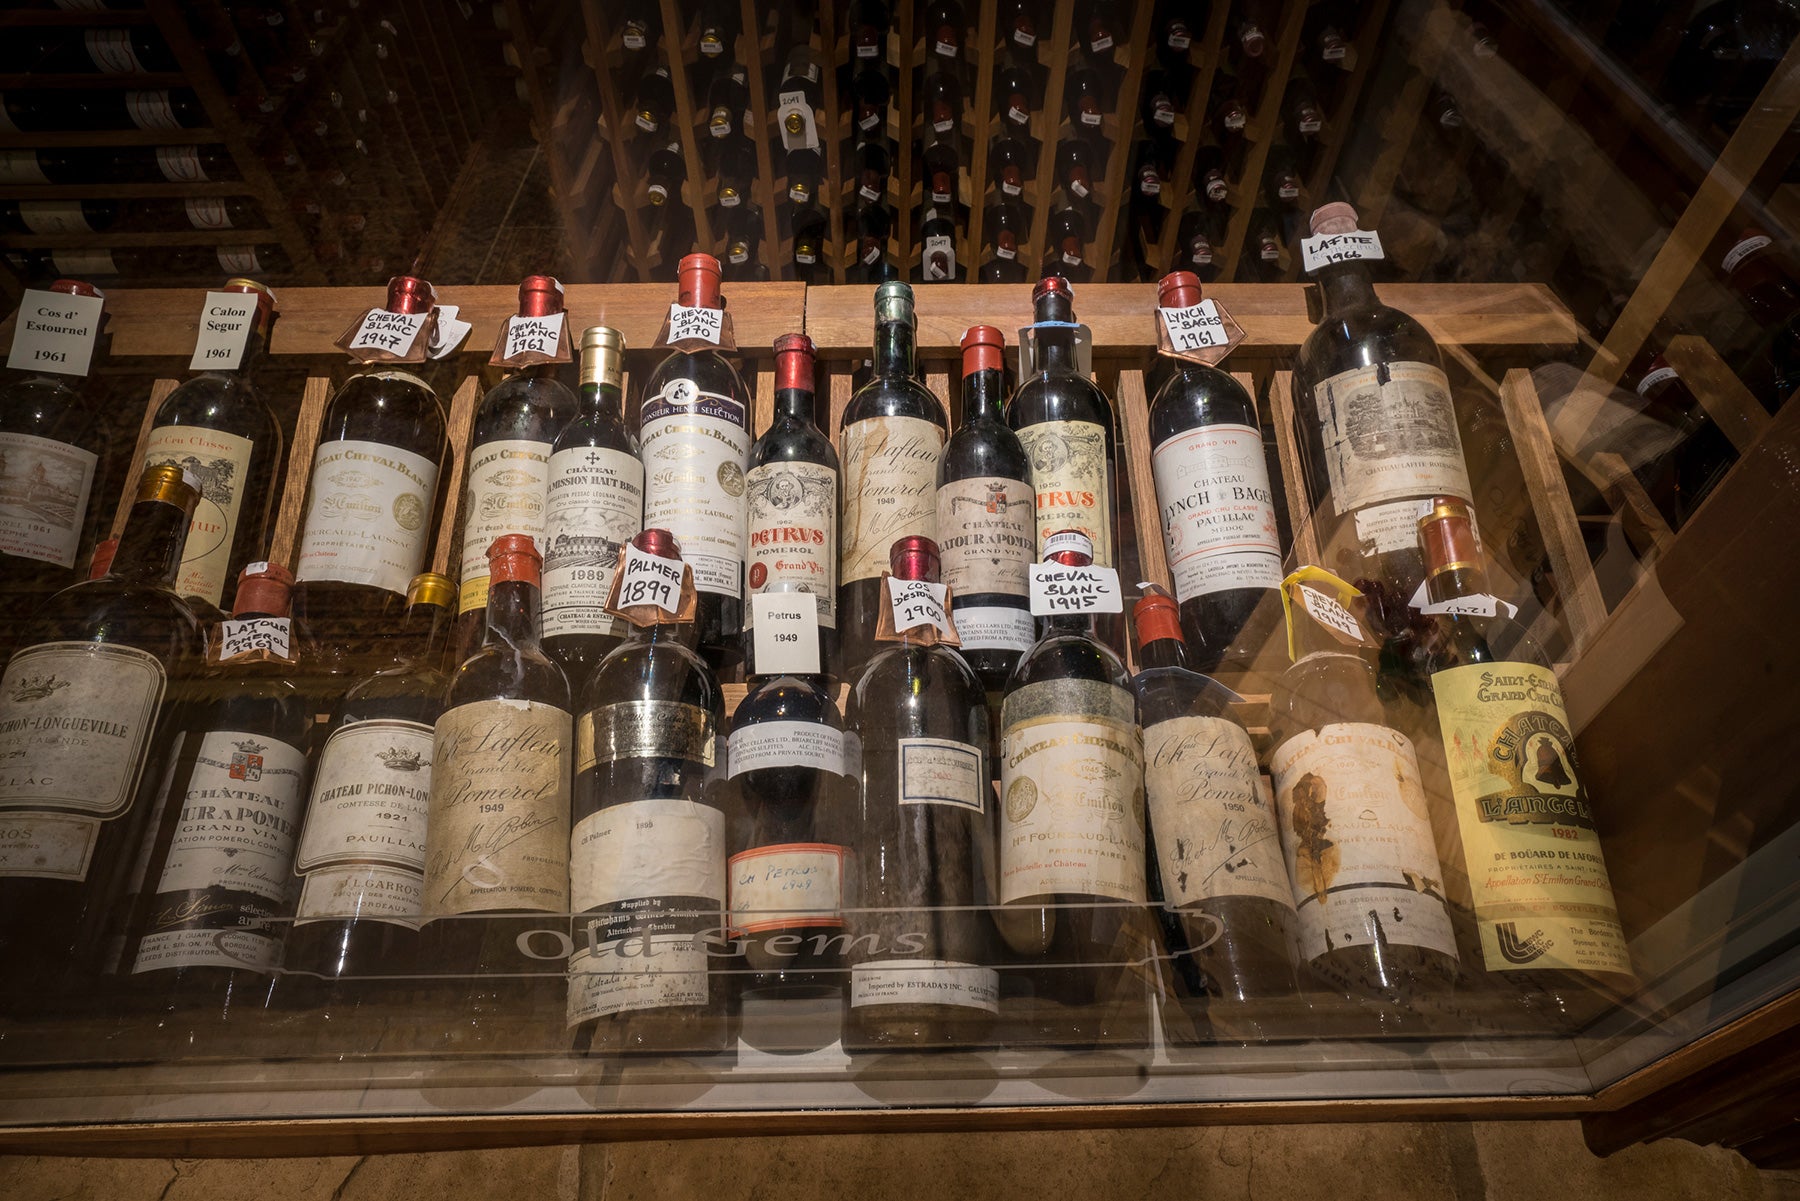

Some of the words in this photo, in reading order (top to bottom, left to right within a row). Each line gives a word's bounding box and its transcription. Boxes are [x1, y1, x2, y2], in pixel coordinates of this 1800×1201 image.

[1309, 235, 1373, 254] LAFITE
[1326, 250, 1362, 263] 1966
[37, 307, 61, 318] Cos
[64, 311, 78, 320] d'
[210, 306, 246, 317] Calon
[673, 309, 718, 321] CHEVAL
[1165, 306, 1206, 323] LYNCH
[26, 320, 88, 336] Estournel
[206, 320, 242, 333] Segur
[367, 313, 417, 329] CHEVAL
[509, 320, 548, 336] CHEVAL
[677, 316, 719, 328] BLANC
[1181, 316, 1222, 330] BAGES
[365, 322, 412, 336] BLANC
[512, 328, 557, 341] BLANC
[673, 325, 710, 340] 1970
[359, 333, 402, 349] 1947
[512, 338, 545, 355] 1961
[1180, 330, 1216, 349] 1961
[34, 350, 66, 362] 1961
[205, 349, 231, 359] 1961
[701, 406, 740, 423] SELECTION
[713, 429, 744, 457] BLANC
[1188, 440, 1218, 451] GRAND
[345, 450, 395, 470] CHEVAL
[396, 461, 429, 491] BLANC
[551, 476, 588, 491] MISSION
[591, 475, 619, 488] HAUT
[857, 479, 934, 499] Pomerol
[1039, 481, 1061, 489] 1950
[877, 497, 896, 505] 1949
[1036, 490, 1096, 510] TRVS
[1165, 491, 1210, 520] LYNCH
[1188, 511, 1211, 521] GRAND
[1215, 506, 1231, 514] CRU
[1196, 513, 1256, 528] PAUILLAC
[756, 547, 815, 556] POMEROL
[628, 558, 681, 586] PALMER
[775, 560, 807, 571] Grand
[571, 569, 605, 581] 1989
[1035, 570, 1103, 583] CHEVAL
[622, 580, 671, 605] 1899
[907, 582, 930, 592] COS
[1044, 584, 1110, 595] BLANC
[1049, 596, 1098, 610] 1945
[1303, 589, 1351, 616] CHEVAL
[768, 611, 802, 620] Petrus
[905, 605, 941, 622] 1900
[1311, 600, 1358, 626] BLANC
[226, 619, 288, 638] LATOUR
[1313, 609, 1352, 634] 1949
[226, 633, 288, 650] POMEROL
[773, 633, 798, 642] 1949
[232, 639, 274, 655] 1961
[1477, 688, 1527, 702] GRAND
[470, 720, 566, 762] Lafleur
[794, 730, 819, 738] PRODUCT
[750, 738, 775, 747] CELLARS
[804, 751, 825, 759] SOURCE
[320, 784, 363, 803] CHATEAU
[440, 779, 556, 811] Pomerol
[337, 800, 386, 810] COMTESSE
[479, 803, 505, 814] 1949
[1223, 802, 1245, 812] 1950
[376, 812, 408, 822] 1921
[182, 824, 246, 834] GRAND
[252, 828, 278, 841] VIN
[590, 829, 612, 842] Palmer
[1551, 828, 1579, 840] 1982
[208, 835, 255, 846] POMEROL
[346, 834, 426, 853] PAUILLAC
[1494, 852, 1507, 861] DE
[1510, 848, 1555, 860] BOÜARD
[1558, 850, 1570, 859] DE
[1485, 874, 1533, 889] Appellation
[1575, 875, 1597, 888] Grand
[470, 886, 507, 896] APPELLATION
[510, 886, 537, 894] POMEROL
[621, 899, 650, 909] Supplied
[652, 899, 662, 907] by
[1569, 927, 1584, 935] The
[142, 934, 171, 946] FRANCE
[515, 927, 662, 960] Old
[691, 927, 928, 958] Gems
[868, 982, 895, 990] Imported
[897, 982, 904, 990] by
[907, 981, 947, 989] ESTRADA'S
